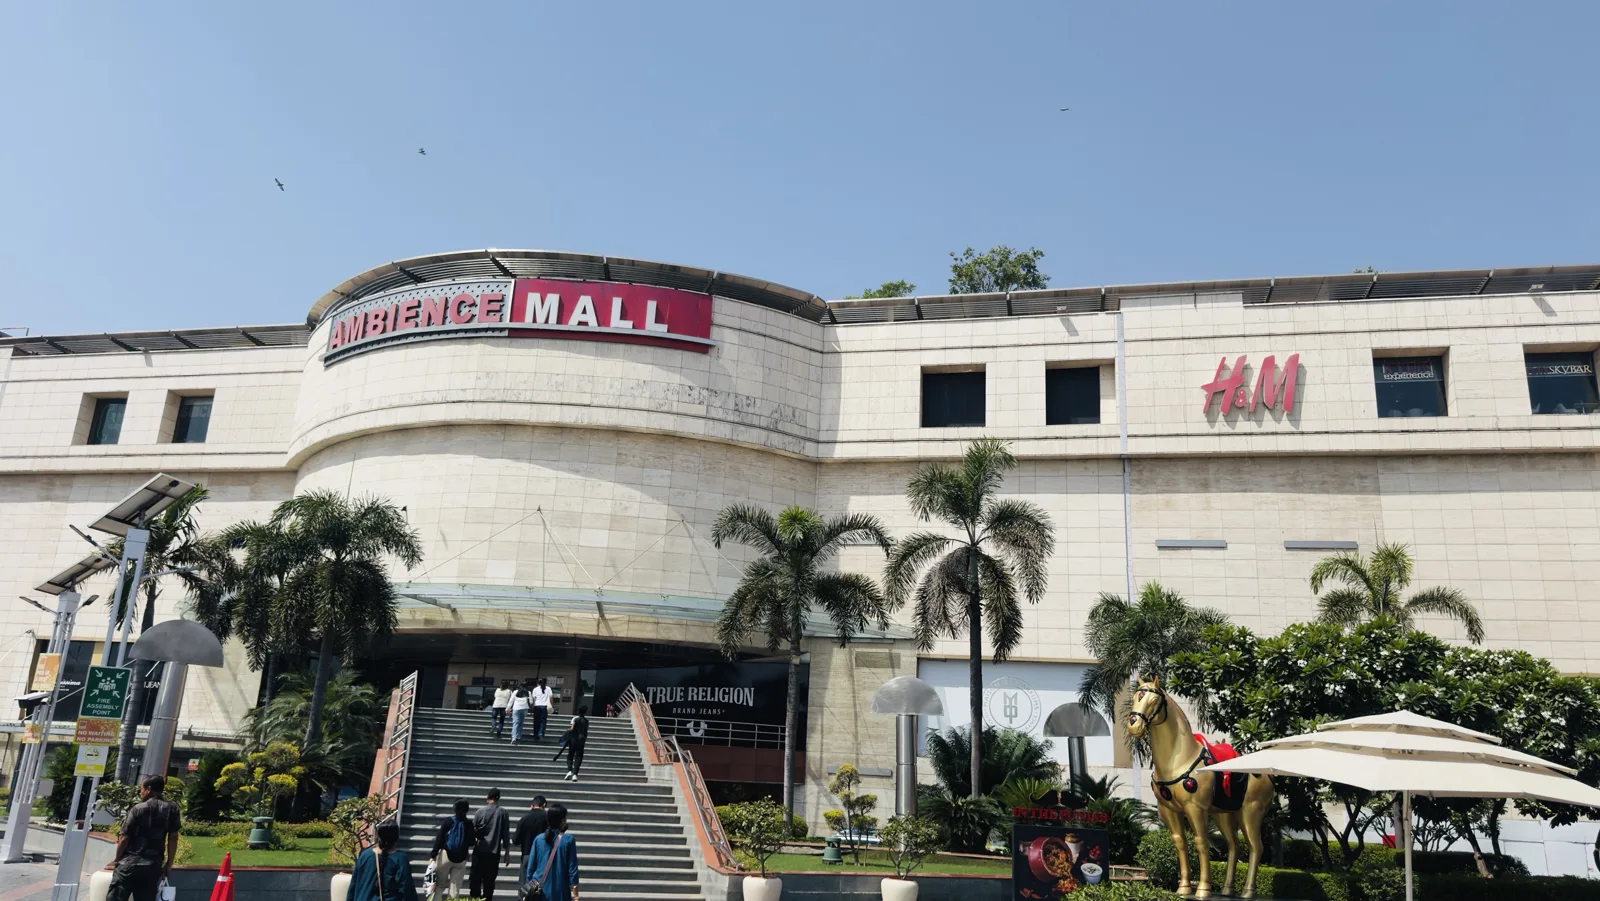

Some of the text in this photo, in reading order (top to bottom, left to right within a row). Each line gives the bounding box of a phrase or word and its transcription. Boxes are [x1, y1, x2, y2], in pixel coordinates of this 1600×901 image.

[330, 292, 669, 349] AMBIENCE MALL
[1384, 371, 1433, 380] experience
[1549, 365, 1592, 375] SKYBAR
[1200, 353, 1299, 415] H&M
[646, 687, 755, 707] TRUE RELIGION
[1012, 806, 1110, 824] IN THE PUNJAB
